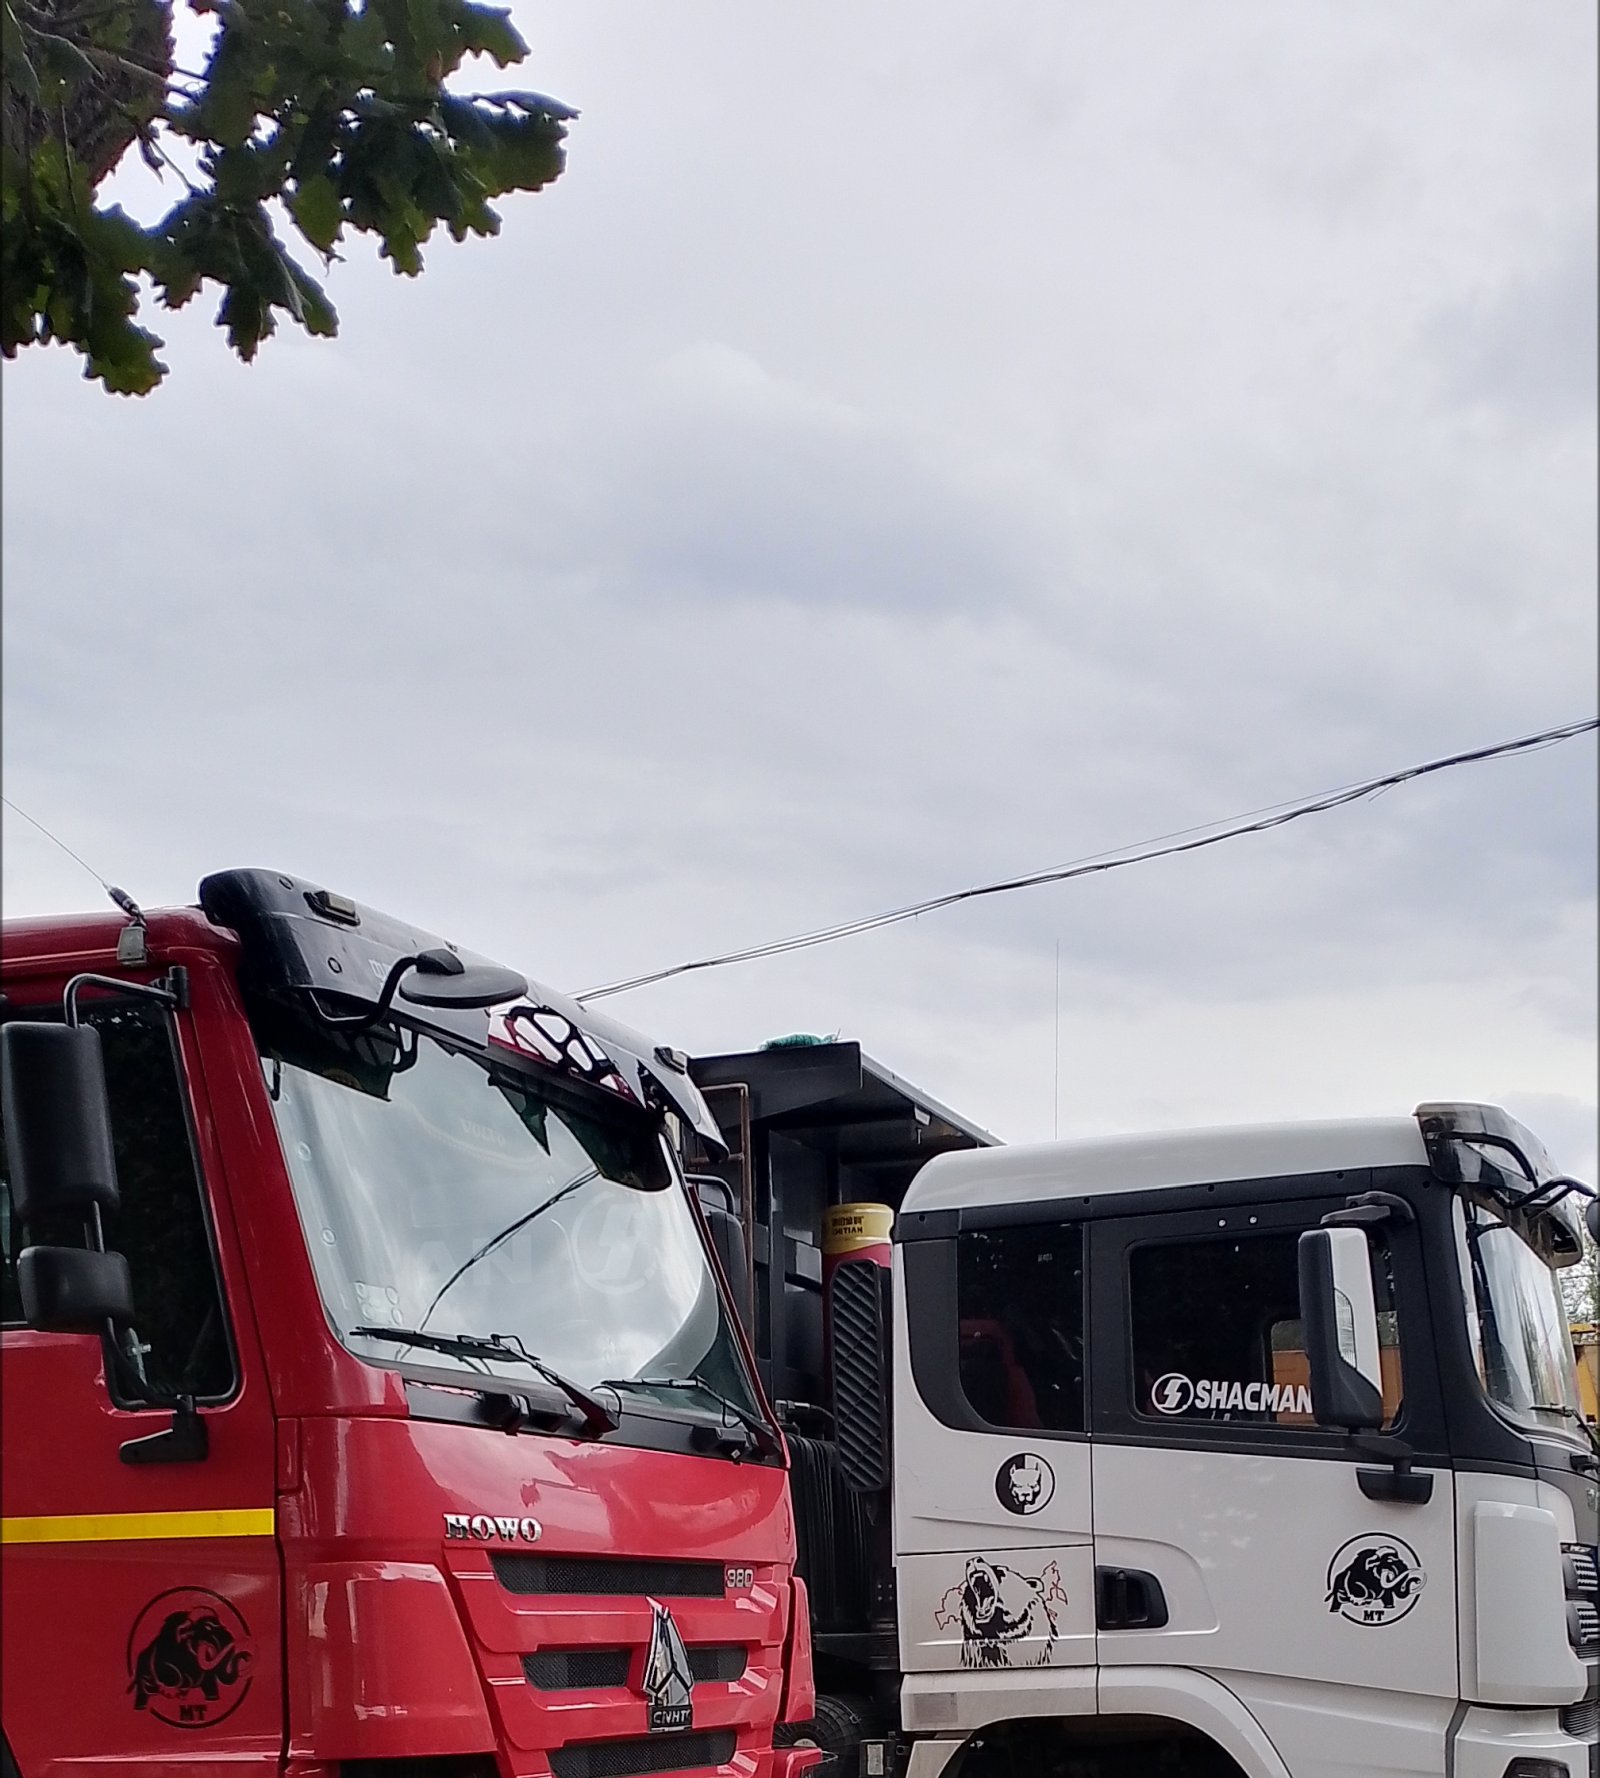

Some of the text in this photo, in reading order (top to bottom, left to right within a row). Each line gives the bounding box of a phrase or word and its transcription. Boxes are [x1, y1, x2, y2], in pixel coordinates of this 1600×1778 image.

[1195, 1379, 1313, 1414] SHACMAN
[443, 1513, 543, 1542] HOWO
[726, 1568, 754, 1588] 380
[1363, 1610, 1385, 1621] MT
[179, 1704, 207, 1721] MT
